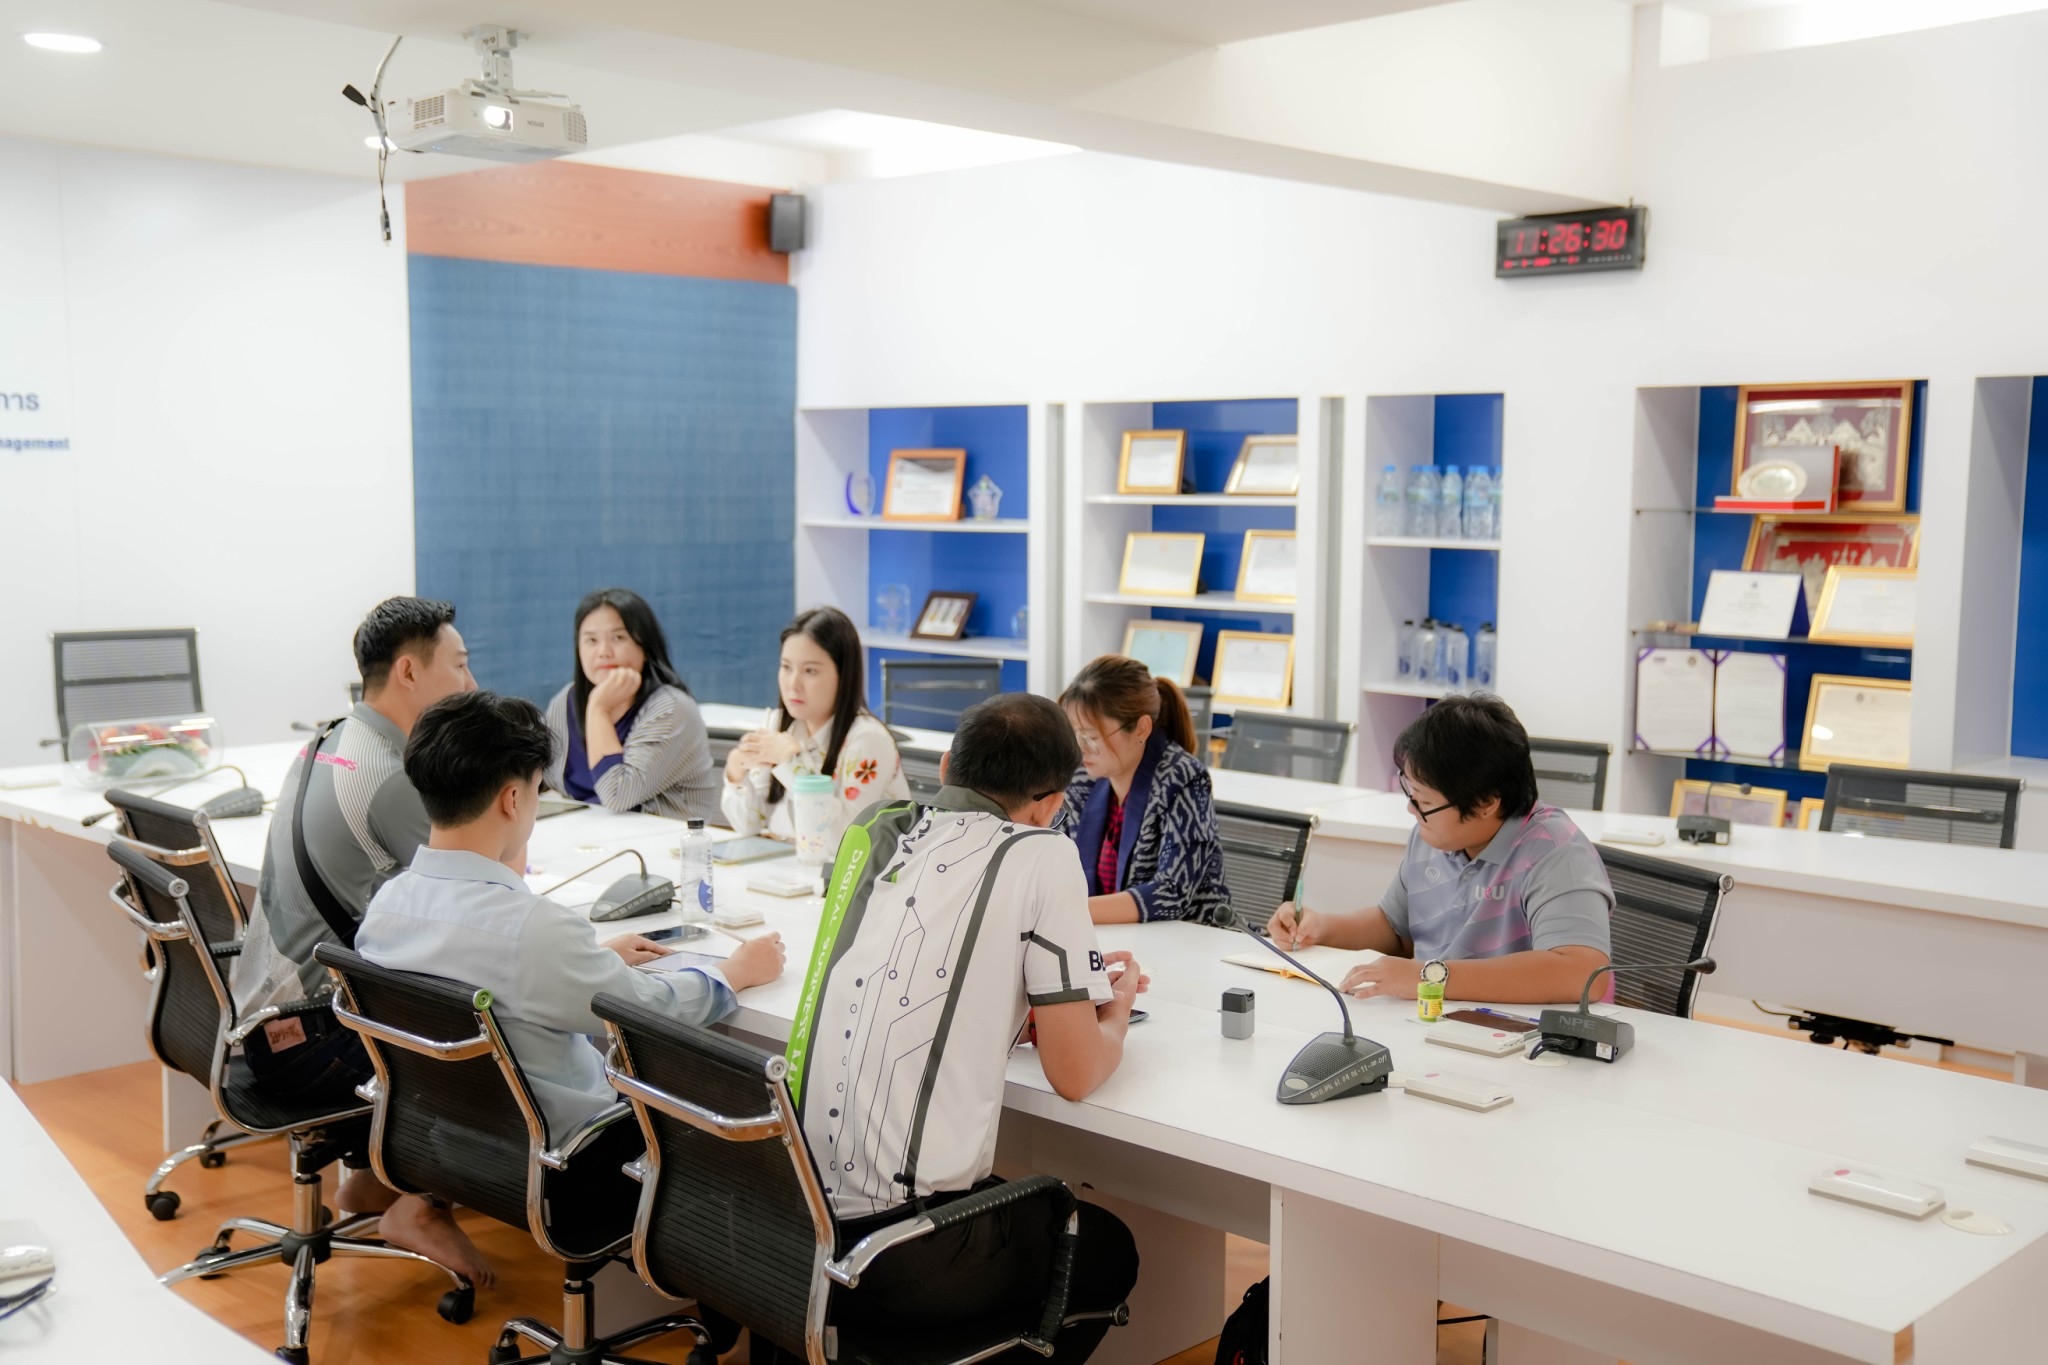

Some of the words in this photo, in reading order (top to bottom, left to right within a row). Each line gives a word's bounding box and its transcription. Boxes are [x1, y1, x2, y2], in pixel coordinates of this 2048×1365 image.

[1516, 219, 1629, 255] 11:26:30
[829, 849, 863, 927] DIGITAL
[797, 936, 831, 1039] BUSINESS
[1559, 1015, 1596, 1030] NPE
